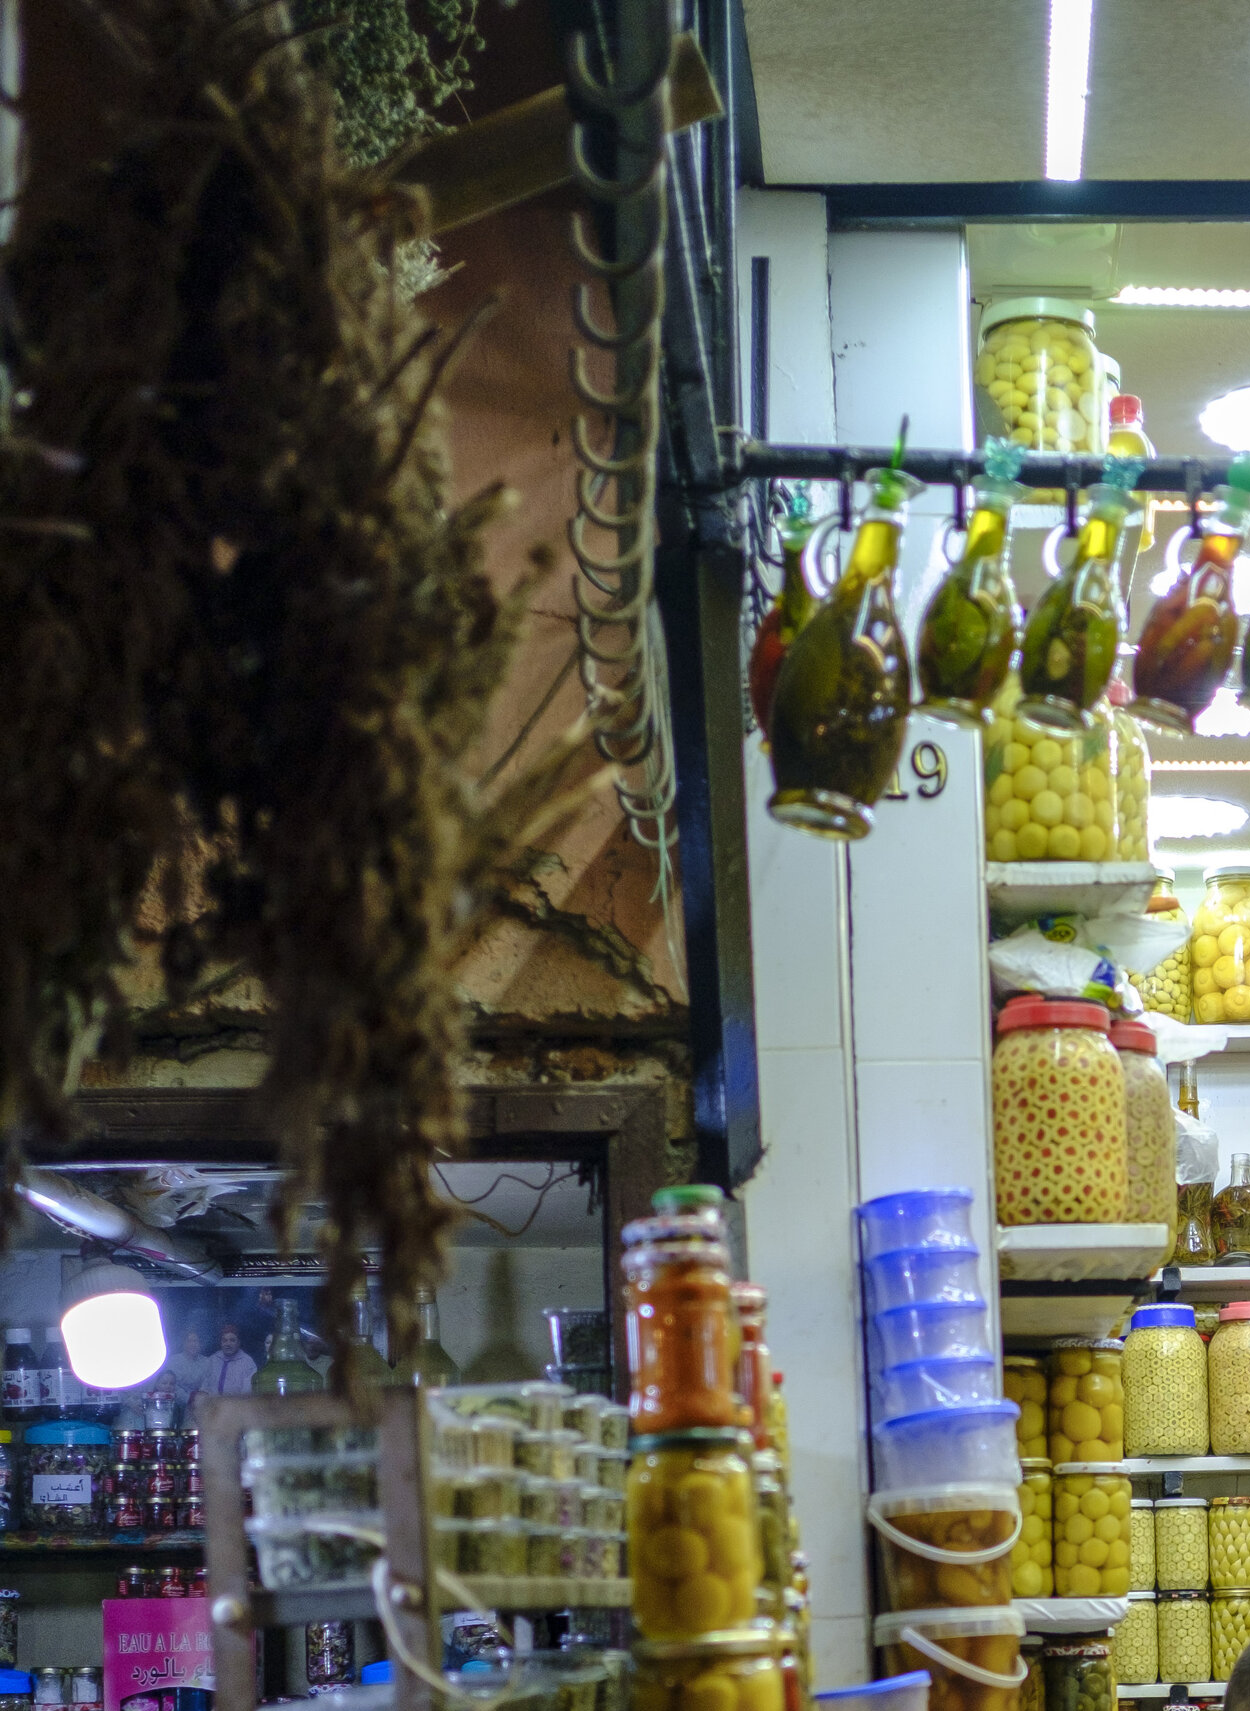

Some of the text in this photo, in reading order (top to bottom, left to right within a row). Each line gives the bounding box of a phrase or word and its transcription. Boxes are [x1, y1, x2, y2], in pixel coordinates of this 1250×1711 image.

[119, 1633, 151, 1653] EAU
[154, 1632, 166, 1652] A
[170, 1632, 191, 1652] LA
[132, 1657, 186, 1686] بالورد
